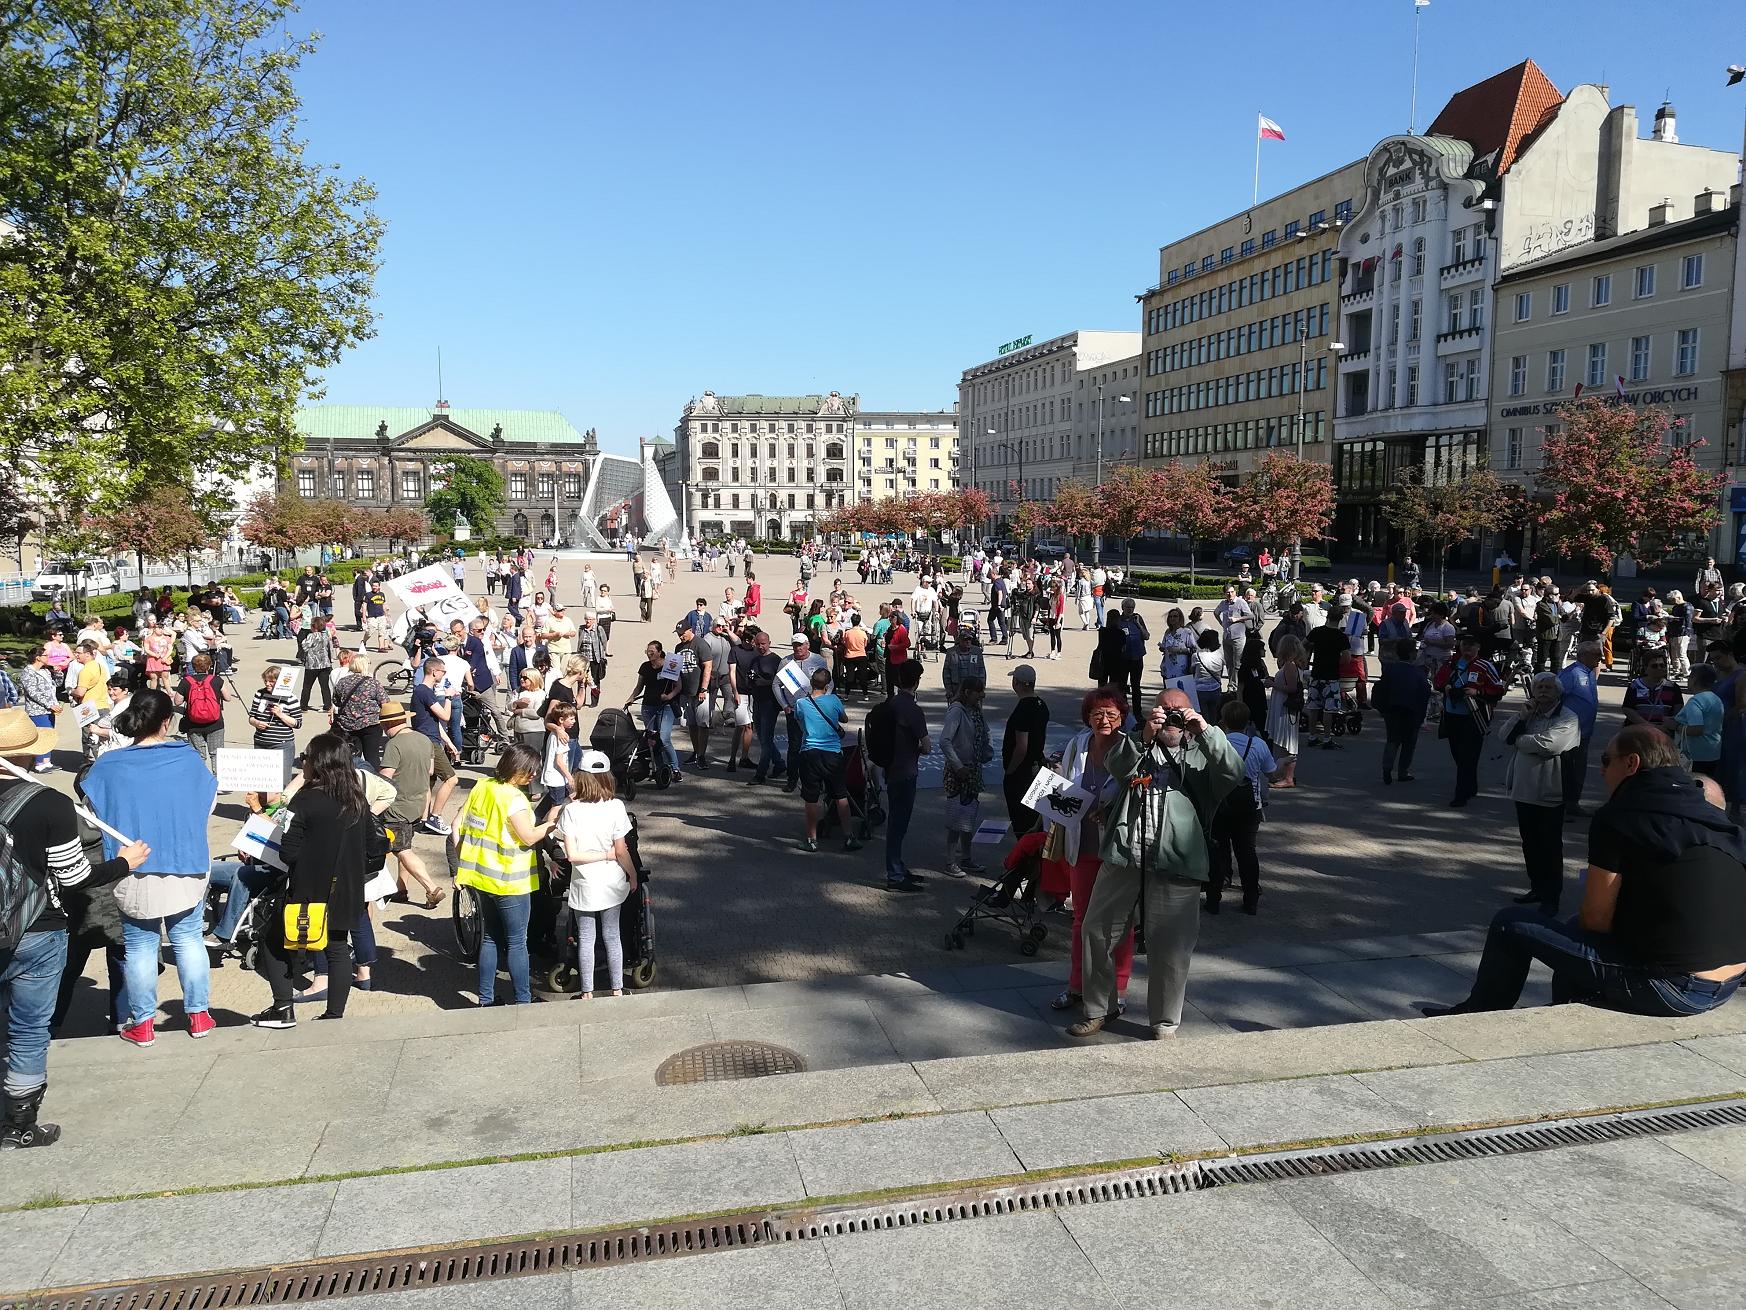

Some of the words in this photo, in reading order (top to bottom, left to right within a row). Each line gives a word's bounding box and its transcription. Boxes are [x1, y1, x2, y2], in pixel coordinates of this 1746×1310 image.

[1388, 172, 1412, 188] BANK
[1500, 404, 1540, 418] OMNIBUS
[1642, 387, 1698, 405] OBCYCH
